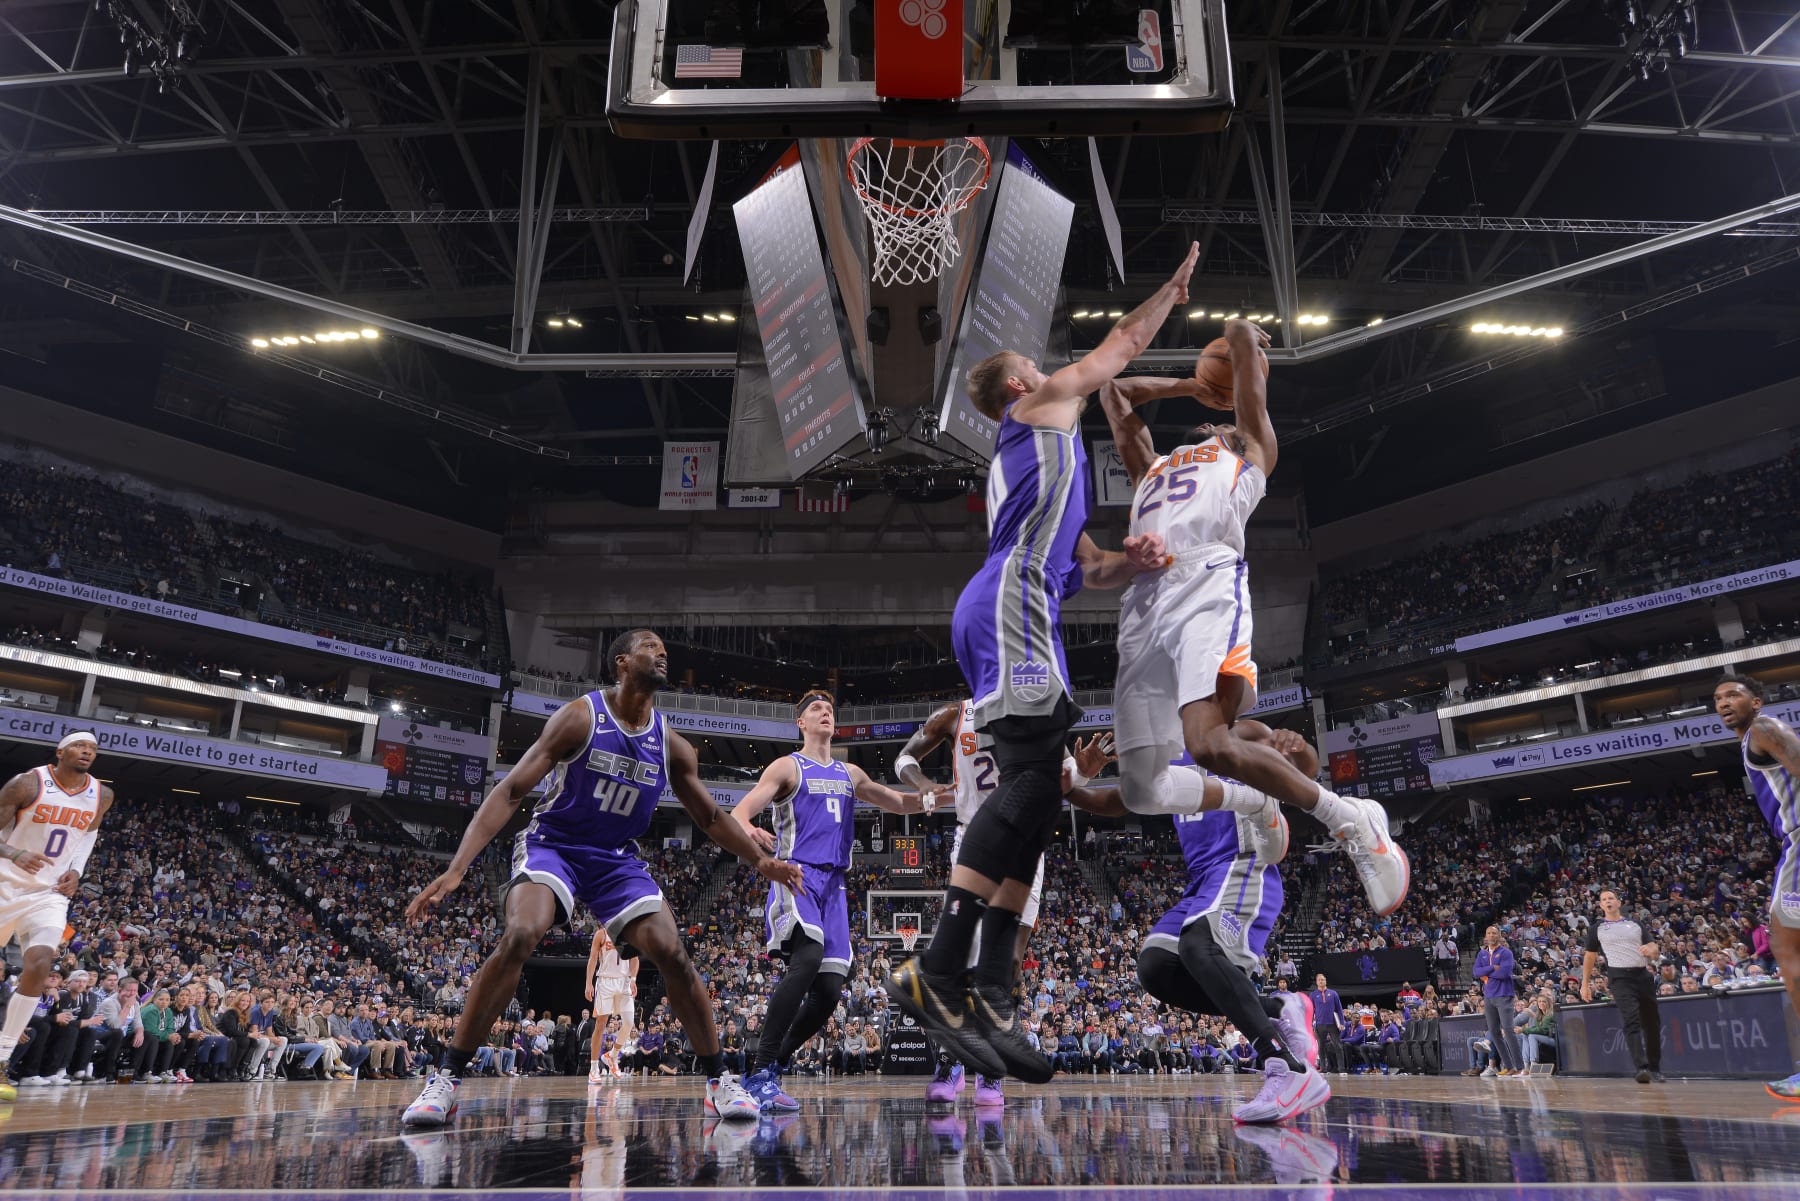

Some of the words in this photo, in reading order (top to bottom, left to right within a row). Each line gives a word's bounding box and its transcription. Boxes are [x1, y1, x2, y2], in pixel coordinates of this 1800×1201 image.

[1132, 57, 1150, 68] NBA
[740, 495, 768, 503] 2001-02
[1138, 466, 1199, 520] 25
[11, 571, 25, 583] to
[28, 577, 67, 593] Apple
[71, 585, 113, 602] Wallet
[116, 594, 128, 606] to
[132, 599, 150, 611] get
[154, 604, 198, 622] started
[1606, 603, 1634, 616] Less
[1637, 592, 1687, 608] waiting.
[1690, 584, 1723, 597] More
[1727, 567, 1791, 588] cheering.
[354, 647, 377, 659] Less
[379, 654, 417, 669] waiting.
[420, 663, 444, 673] More
[446, 667, 488, 685] cheering.
[1012, 676, 1048, 686] SAC
[1258, 691, 1298, 708] started
[598, 714, 606, 723] 6
[667, 714, 696, 727] More
[699, 717, 751, 732] cheering.
[9, 717, 55, 735] card
[145, 735, 201, 757] Wallet
[207, 747, 223, 760] to
[228, 752, 255, 766] get
[260, 756, 318, 775] started
[1552, 744, 1592, 760] Less
[1596, 731, 1669, 752] waiting.
[1674, 723, 1723, 741] More
[586, 748, 660, 786] SAC
[593, 778, 640, 817] 40
[806, 779, 852, 797] SAC
[32, 803, 94, 831] SUNS
[827, 798, 842, 824] 9
[44, 828, 68, 857] 0
[895, 839, 915, 849] 33.3
[903, 850, 918, 866] 18
[900, 1042, 926, 1050] dialpad
[1686, 1018, 1767, 1050] ULTRA
[1443, 1047, 1464, 1060] LIGHT
